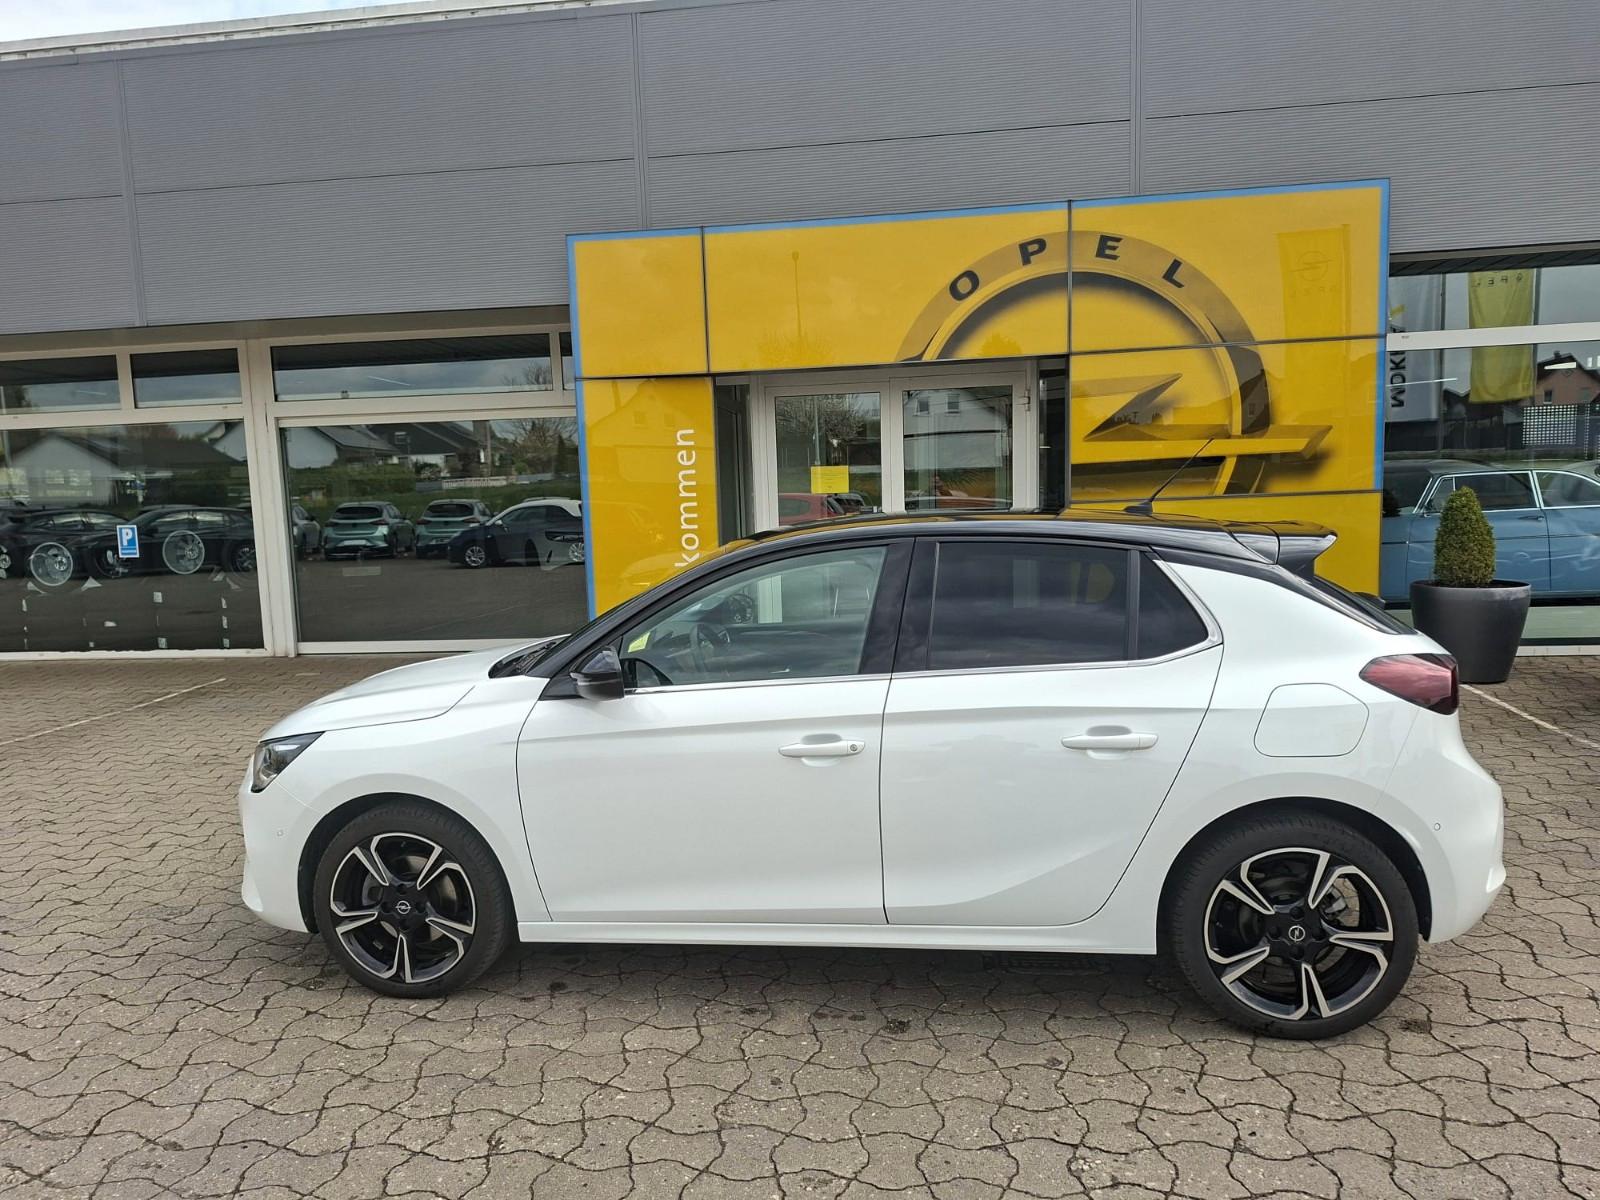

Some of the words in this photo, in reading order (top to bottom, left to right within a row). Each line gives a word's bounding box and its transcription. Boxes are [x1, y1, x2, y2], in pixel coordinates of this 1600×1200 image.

[948, 234, 1186, 301] OPEL
[674, 428, 700, 567] kommen
[121, 527, 133, 546] P
